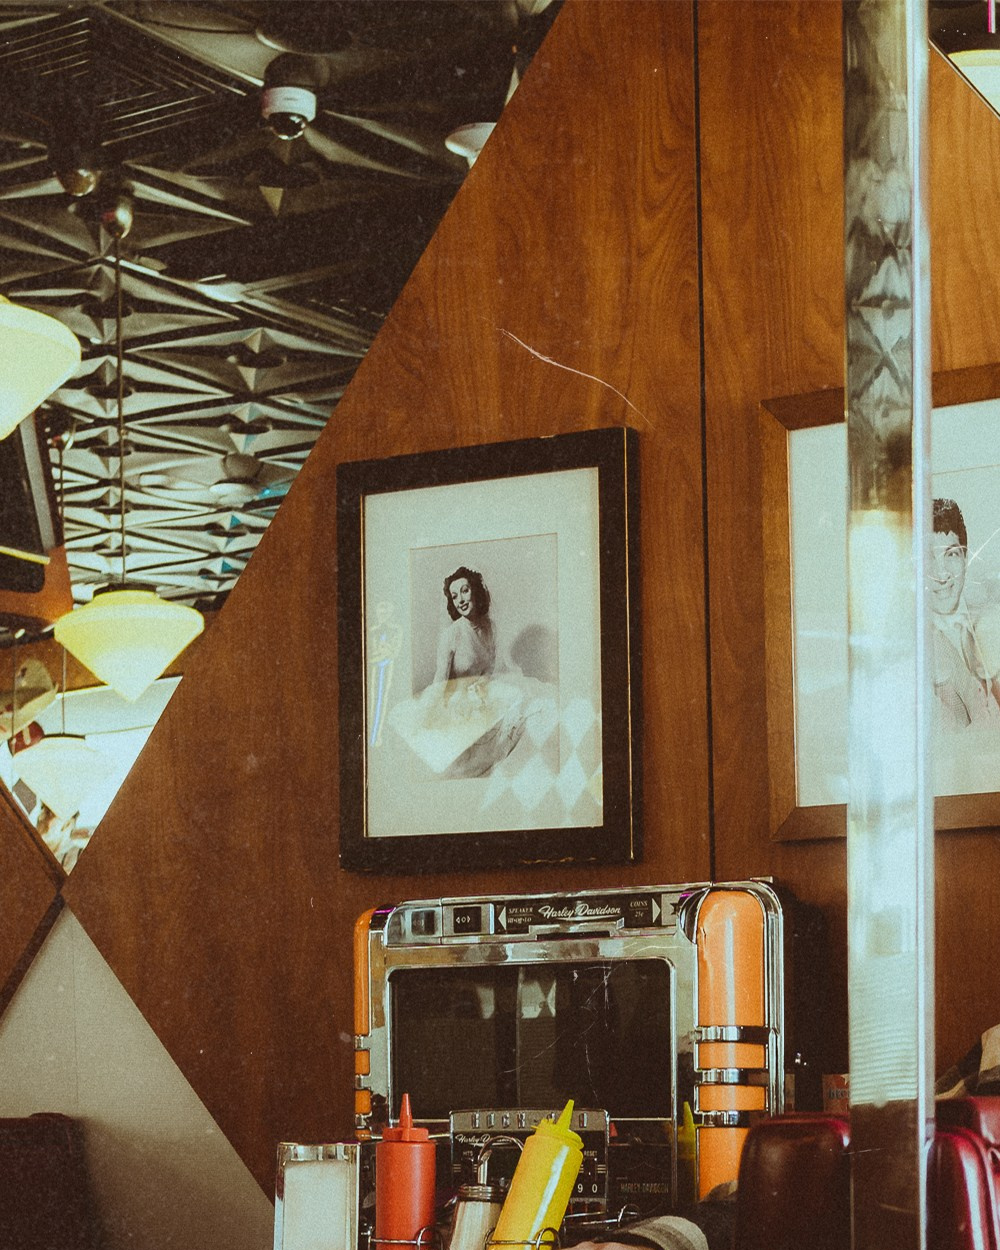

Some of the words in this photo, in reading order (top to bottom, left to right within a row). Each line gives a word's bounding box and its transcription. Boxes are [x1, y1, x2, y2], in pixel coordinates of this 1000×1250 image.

[538, 905, 574, 921] Harley
[577, 1183, 583, 1193] 9
[592, 1183, 598, 1193] 0
